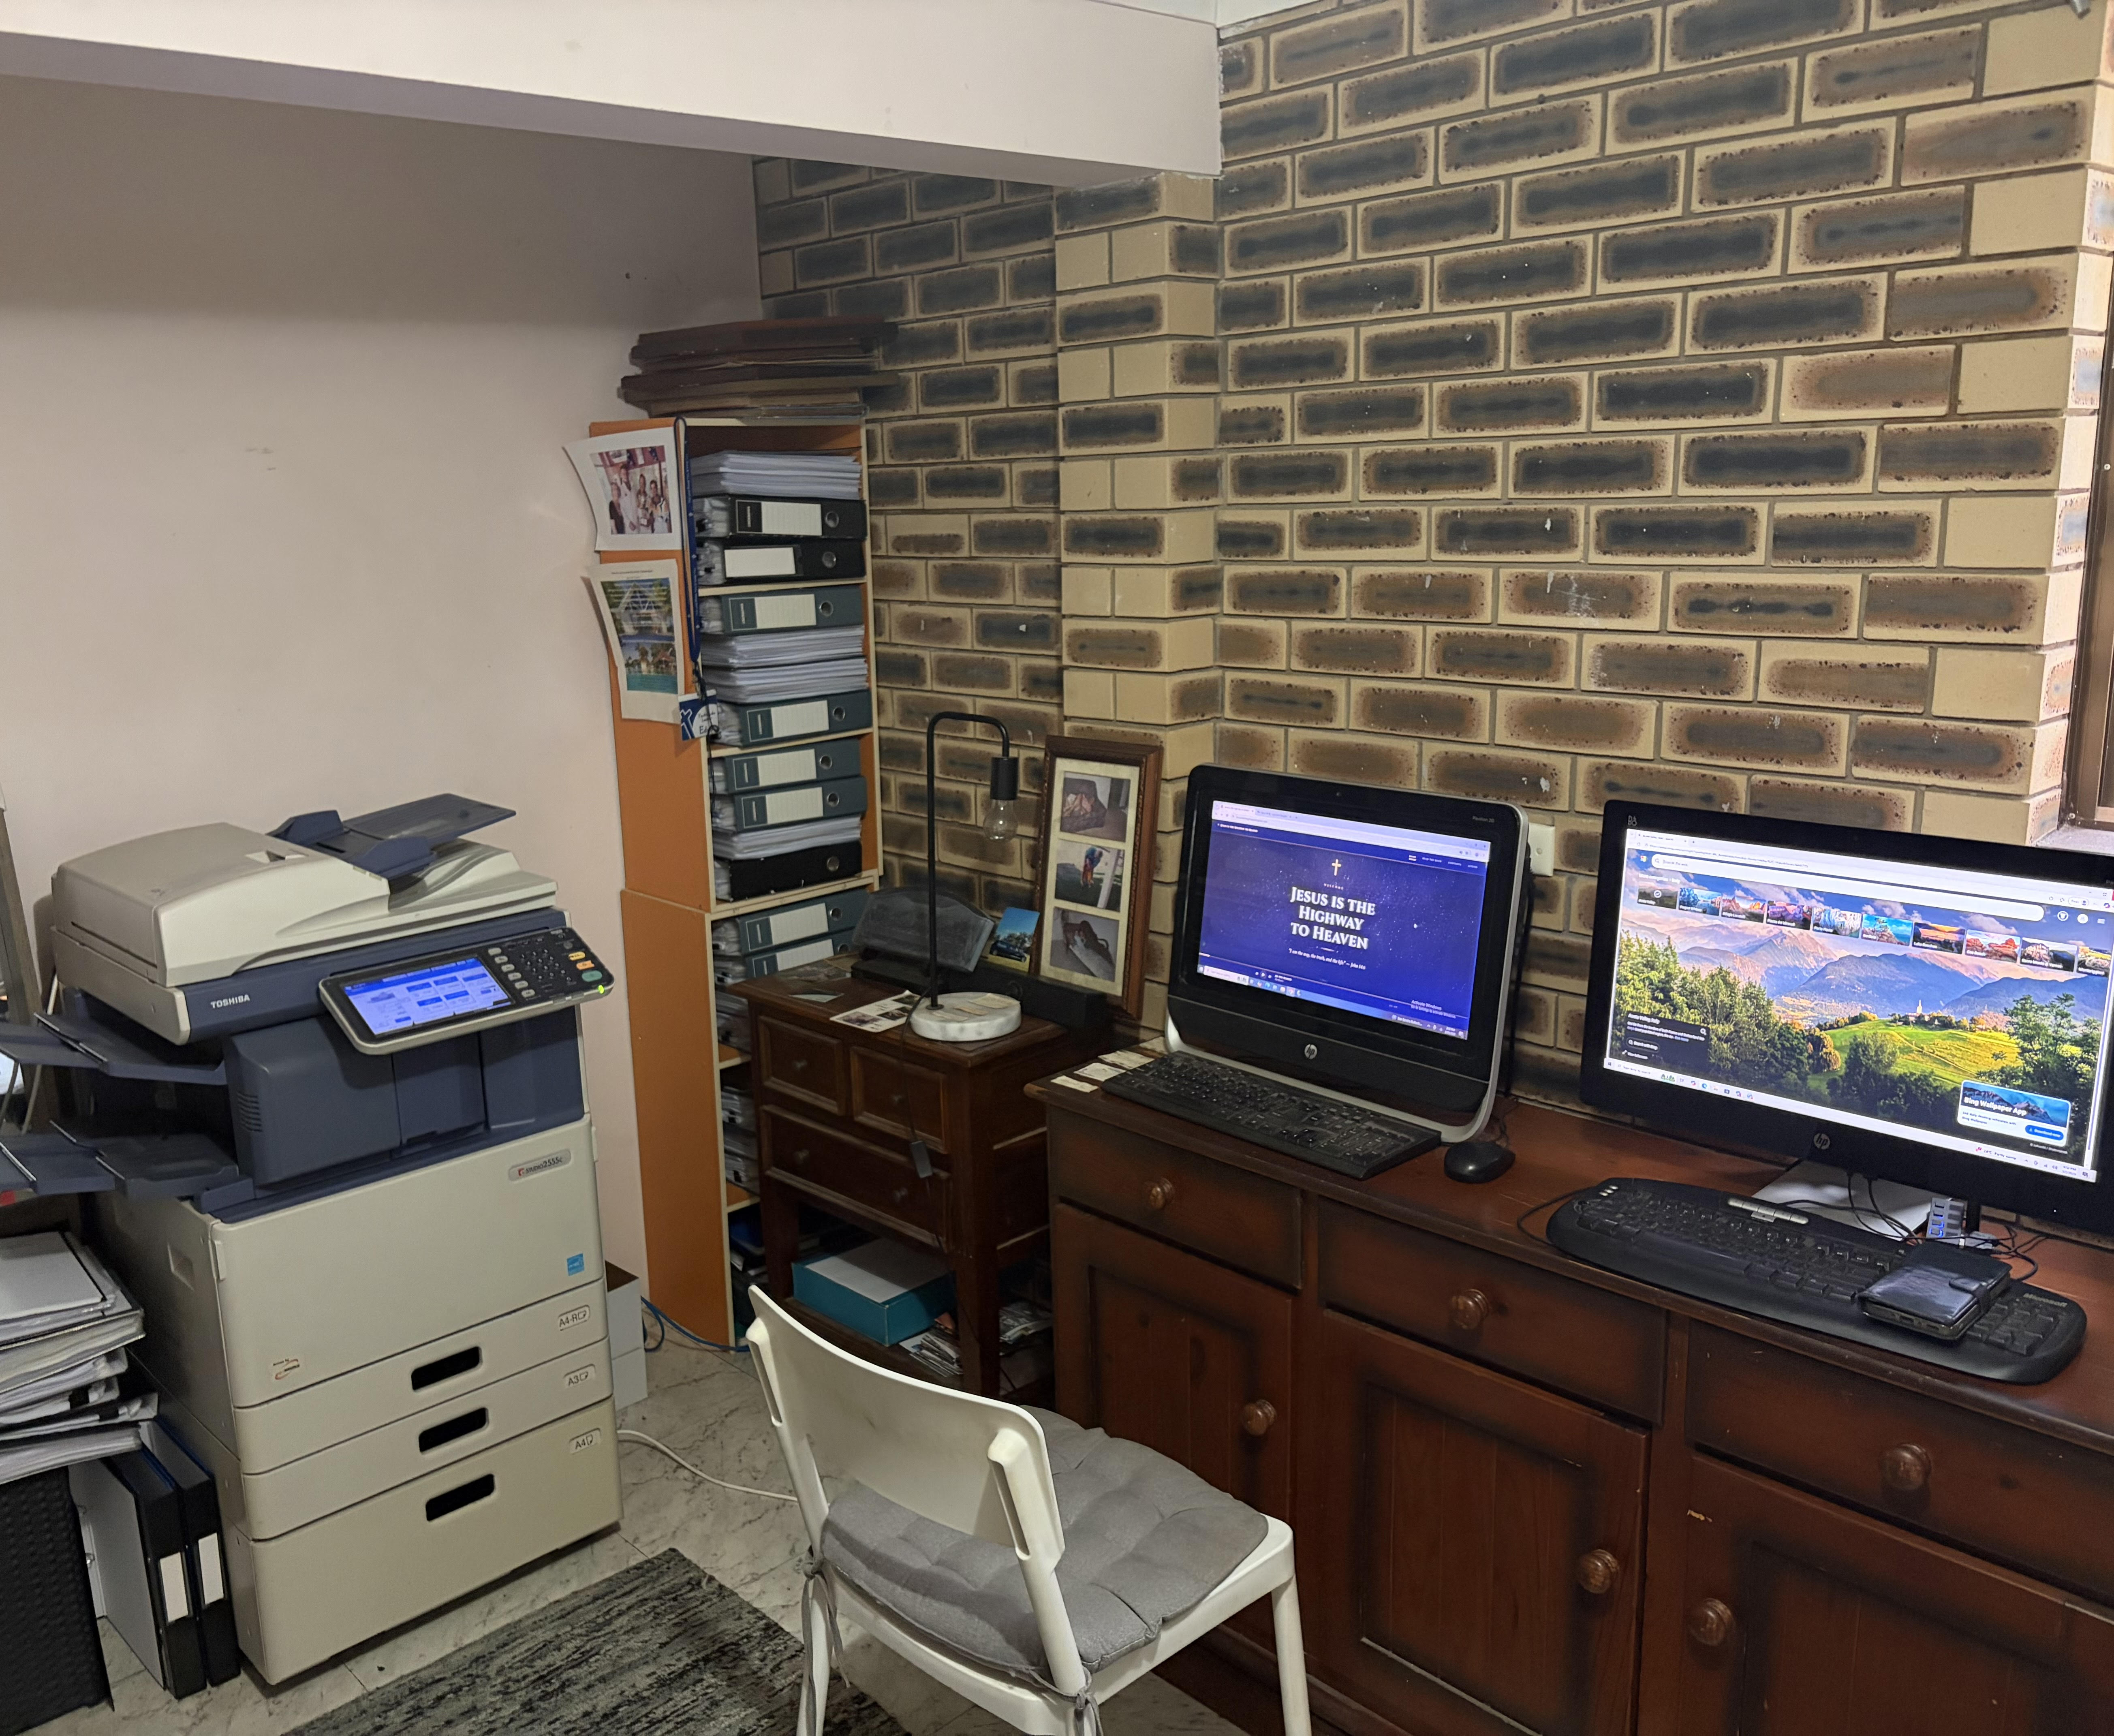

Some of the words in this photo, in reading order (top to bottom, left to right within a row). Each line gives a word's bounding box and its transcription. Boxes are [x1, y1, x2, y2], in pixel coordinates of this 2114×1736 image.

[1290, 886, 1329, 906] JESUS
[1331, 896, 1345, 909] IS
[1347, 898, 1376, 916] THE
[1298, 905, 1365, 930] HIGHWAY
[1290, 922, 1310, 937] TO
[1312, 925, 1369, 950] HEAVEN
[210, 994, 250, 1009] TOSHIBA
[1304, 1044, 1317, 1059] hp
[1964, 1096, 1979, 1107] Bing
[1980, 1099, 2013, 1113] Wallpaper
[2012, 1108, 2027, 1117] App
[1813, 1133, 1830, 1150] hp
[2023, 1293, 2068, 1308] Microsoft
[568, 1375, 579, 1386] A3
[575, 1439, 586, 1450] A4
